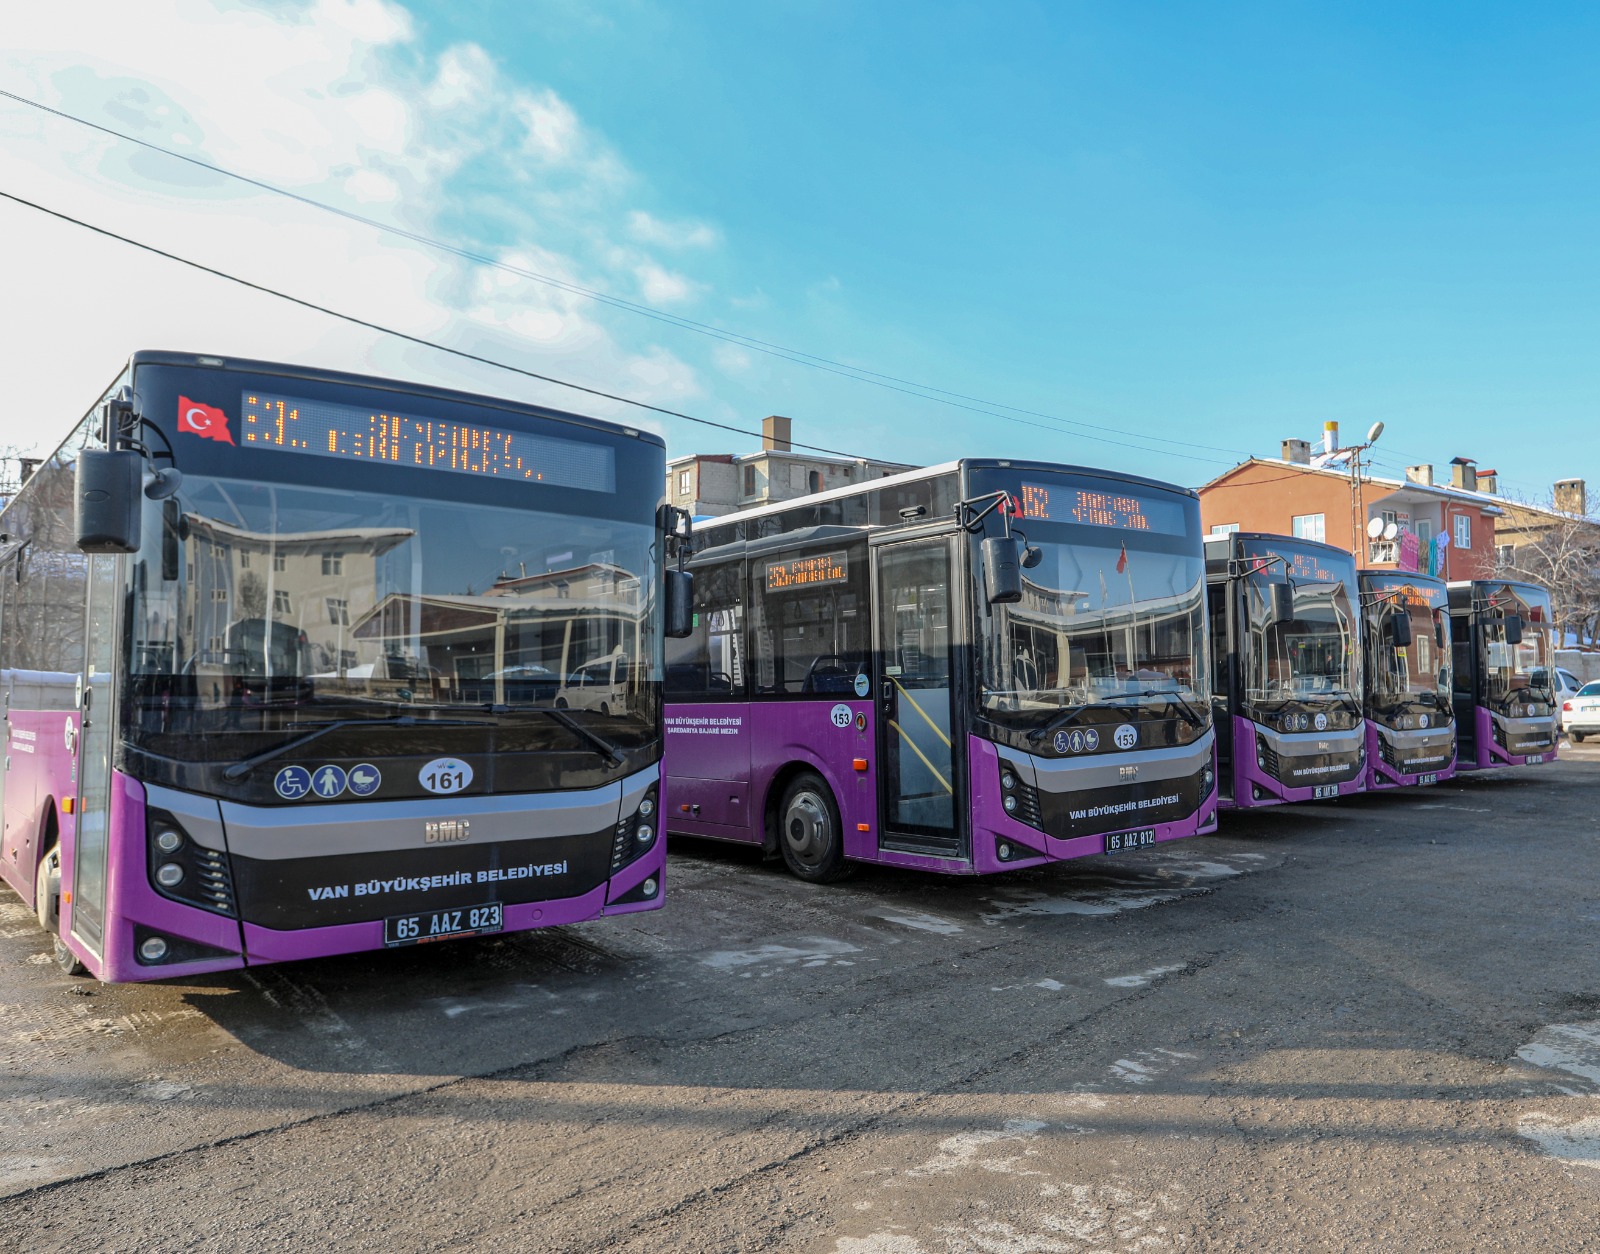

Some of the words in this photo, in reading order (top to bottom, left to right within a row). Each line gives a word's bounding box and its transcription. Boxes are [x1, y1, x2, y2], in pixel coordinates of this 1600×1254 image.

[833, 713, 850, 725] 153
[1117, 733, 1134, 747] 153
[426, 771, 464, 790] 161
[1069, 809, 1087, 819] VAN
[1088, 801, 1137, 817] BÜYÜKŞEHİR
[1138, 793, 1179, 809] BELEDİYESİ
[424, 819, 470, 844] BMC
[1111, 835, 1121, 849] 65
[1123, 832, 1138, 848] AAZ
[1140, 830, 1154, 845] 812
[308, 885, 348, 900] VAN
[354, 870, 472, 897] BÜYÜKŞEHİR
[476, 860, 568, 883] BELEDİYESİ
[396, 916, 420, 939] 65
[430, 911, 462, 935] AAZ
[469, 905, 500, 928] 823
